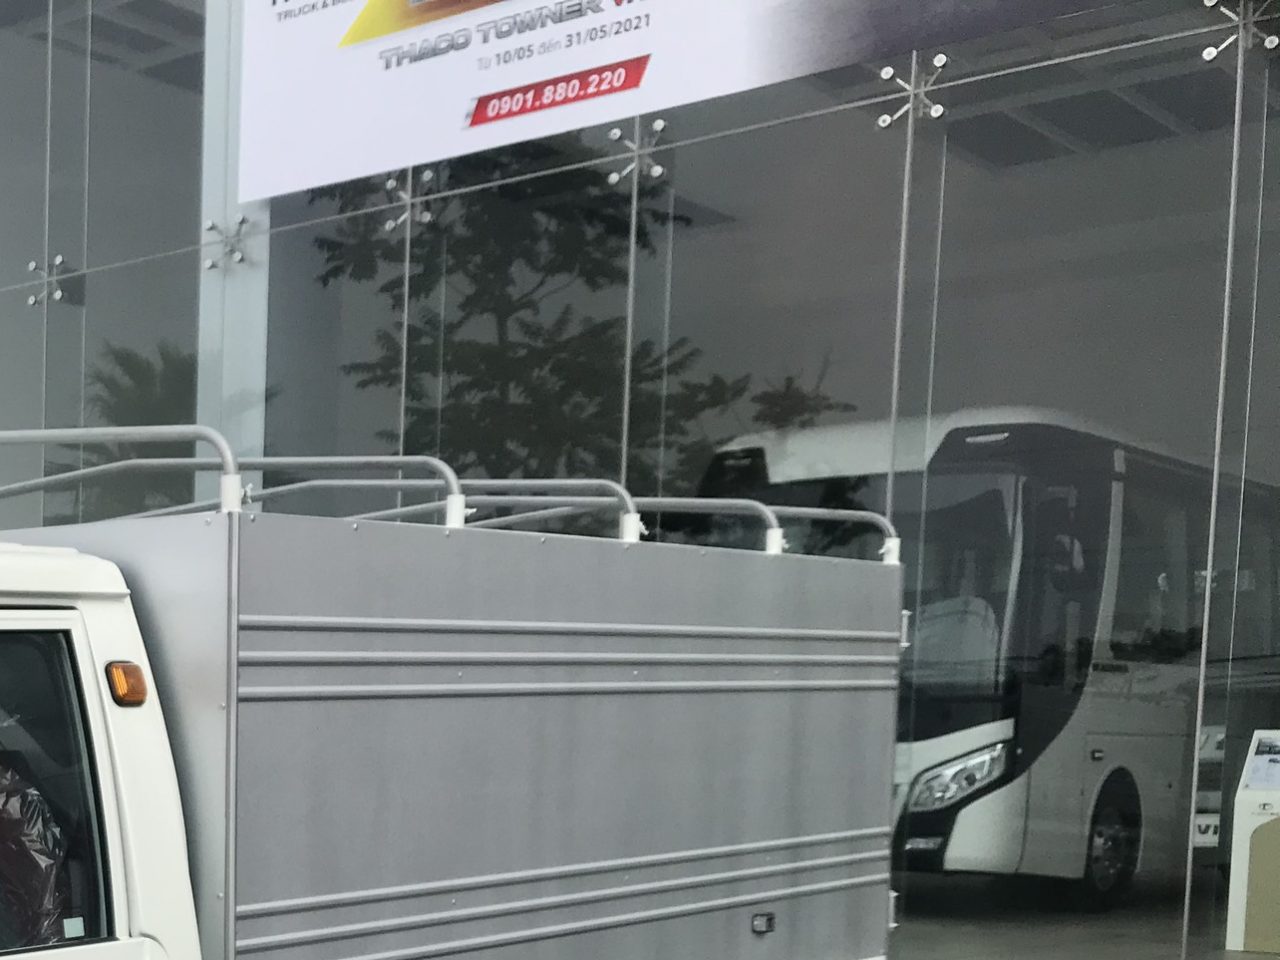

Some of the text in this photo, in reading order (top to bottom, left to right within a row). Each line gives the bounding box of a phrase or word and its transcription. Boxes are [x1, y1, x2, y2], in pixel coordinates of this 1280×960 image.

[277, 1, 318, 22] TRUCK
[379, 0, 604, 70] THACO TOWNER
[495, 45, 534, 66] 10/05
[564, 13, 651, 48] 31/05/2021
[487, 67, 626, 118] 0901.880.220
